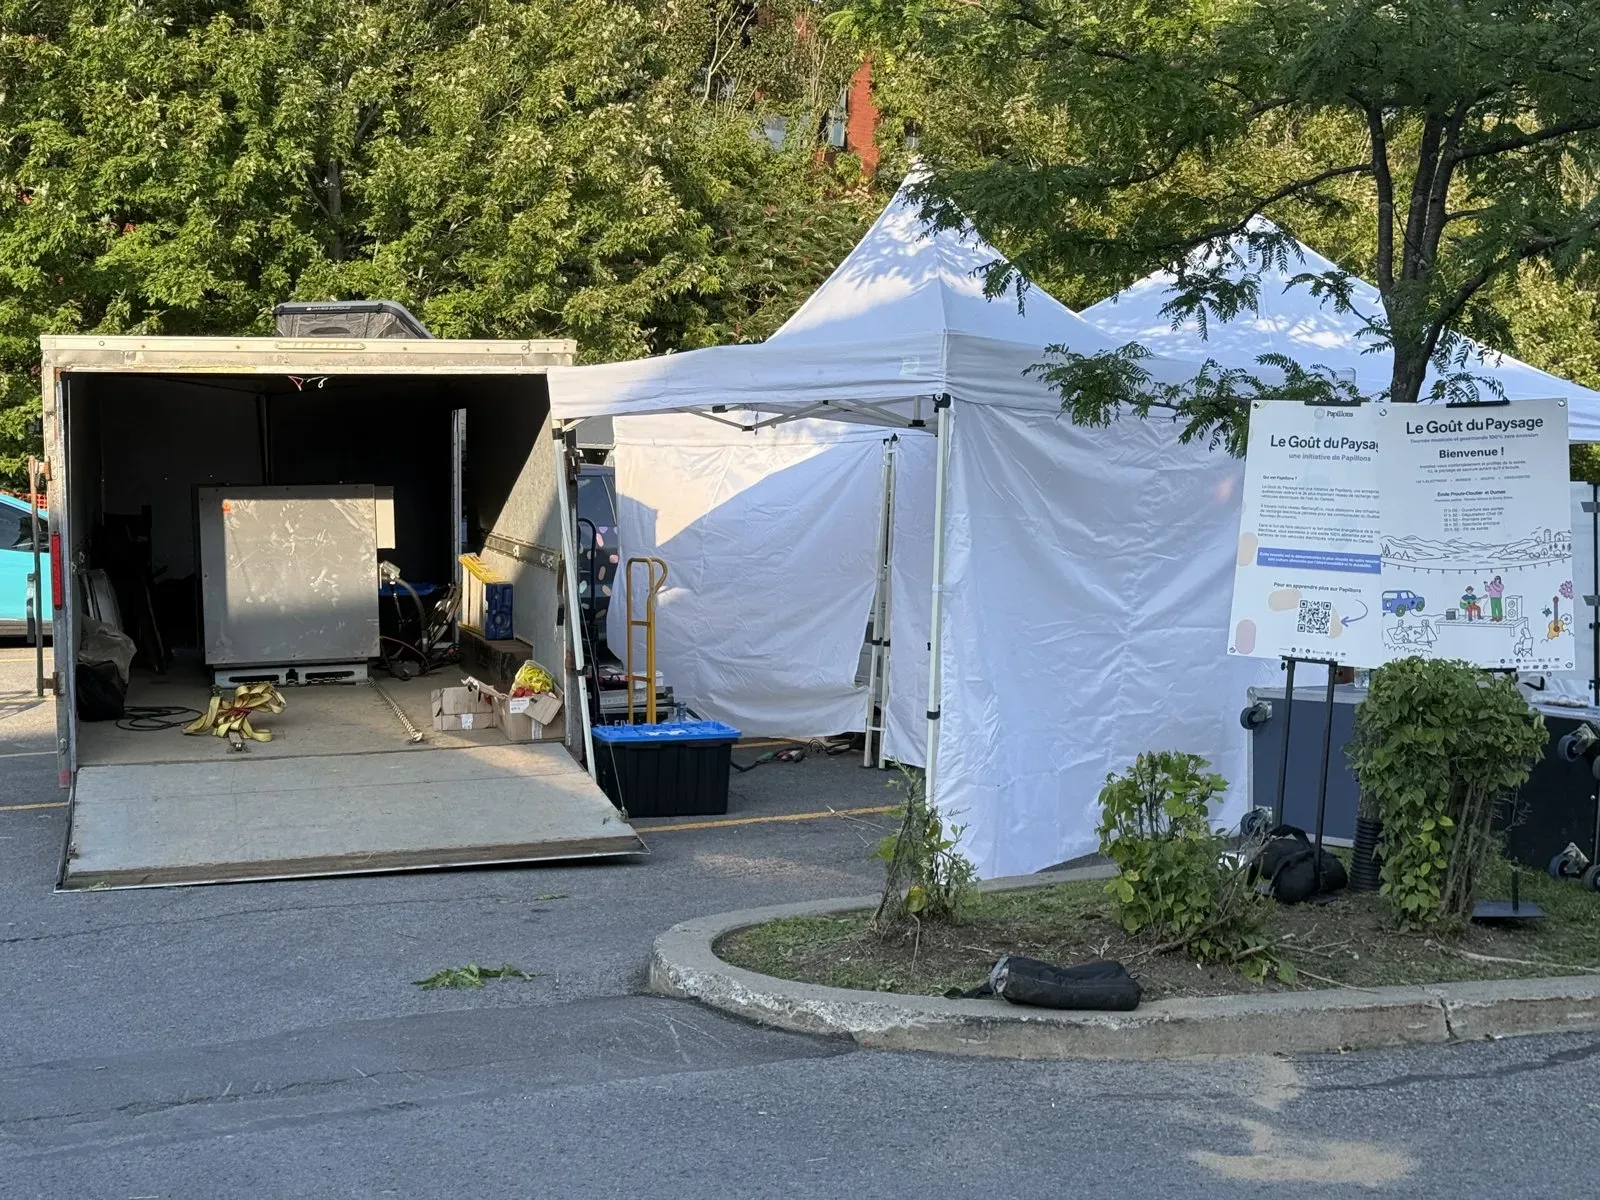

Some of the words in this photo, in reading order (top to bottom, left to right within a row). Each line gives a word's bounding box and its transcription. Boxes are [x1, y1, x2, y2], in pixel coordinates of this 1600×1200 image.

[1326, 410, 1354, 419] Papillons
[1406, 421, 1424, 434] Le
[1426, 419, 1463, 433] Goût
[1466, 418, 1484, 431] du
[1486, 417, 1544, 432] Paysage
[1270, 434, 1286, 447] Le
[1288, 435, 1322, 449] Goût
[1323, 437, 1339, 449] du
[1302, 452, 1331, 460] initiative
[1341, 454, 1371, 462] Papillons
[1439, 448, 1499, 459] Bienvenue
